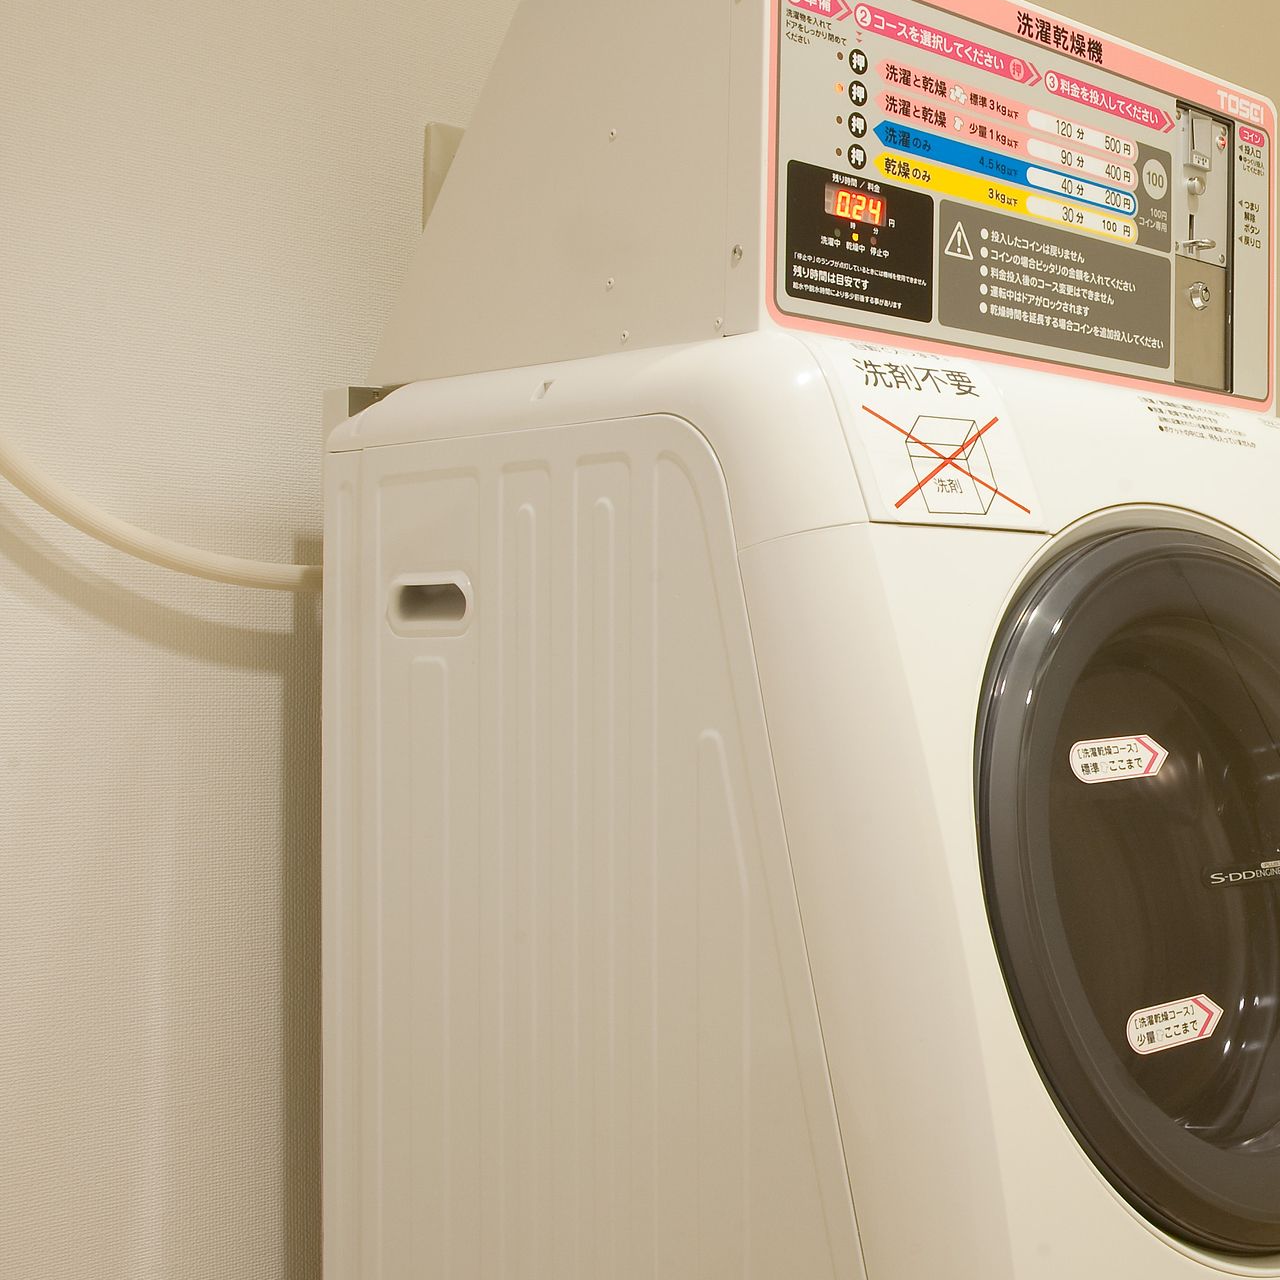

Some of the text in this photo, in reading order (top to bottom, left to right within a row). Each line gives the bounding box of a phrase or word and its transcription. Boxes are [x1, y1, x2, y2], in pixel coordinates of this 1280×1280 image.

[786, 9, 832, 30] 洗濯物を入れて
[786, 21, 847, 46] ドアをしっかり閉めて
[786, 31, 810, 45] ください
[874, 14, 1004, 70] コースを選択してください
[1017, 11, 1103, 65] 洗濯乾燥機
[851, 52, 866, 71] 押
[851, 84, 865, 102] 押
[1060, 79, 1158, 124] 料金を投入してください
[885, 63, 947, 98] 洗濯と乾燥
[970, 93, 988, 108] 標準
[1056, 120, 1072, 138] 120
[1076, 128, 1084, 140] 分
[1104, 136, 1120, 153] 500
[1124, 143, 1131, 155] 円
[851, 116, 865, 134] 押
[885, 94, 947, 128] 洗濯と乾燥
[969, 122, 987, 138] 少量
[1061, 150, 1072, 166] 90
[1077, 156, 1084, 168] 分
[1105, 164, 1121, 181] 400
[1124, 171, 1131, 182] 円
[1243, 130, 1261, 144] コイン
[851, 148, 864, 165] 押
[885, 126, 931, 152] 洗濯のみ
[1061, 178, 1072, 194] 40
[1077, 185, 1084, 196] 分
[1105, 190, 1121, 207] 200
[1124, 198, 1131, 210] 円
[832, 173, 858, 187] 残り時間
[867, 182, 880, 194] 料金
[1146, 171, 1164, 189] 100
[884, 157, 931, 182] 乾燥のみ
[1062, 207, 1074, 223] 30
[1076, 212, 1084, 224] 分
[1102, 220, 1117, 232] 100
[1123, 225, 1131, 237] 円
[1244, 201, 1260, 212] つまり
[888, 218, 895, 228] 円
[1139, 216, 1167, 232] コイン専用
[1150, 208, 1168, 221] 100円
[1244, 224, 1260, 235] ボタン
[870, 246, 890, 259] 停止中
[991, 230, 1085, 264] 投入したコインは戻りません
[792, 265, 870, 291] 残り時間は目安です
[990, 267, 1115, 305] 料金投入後のコース変更はできません
[990, 285, 1090, 317] 運転中はドアがロックされます
[852, 358, 980, 397] 洗剤不要
[933, 478, 963, 494] 洗剤
[1080, 757, 1143, 775] 標準 ここまで
[1137, 1019, 1198, 1047] 少量 ここまで
